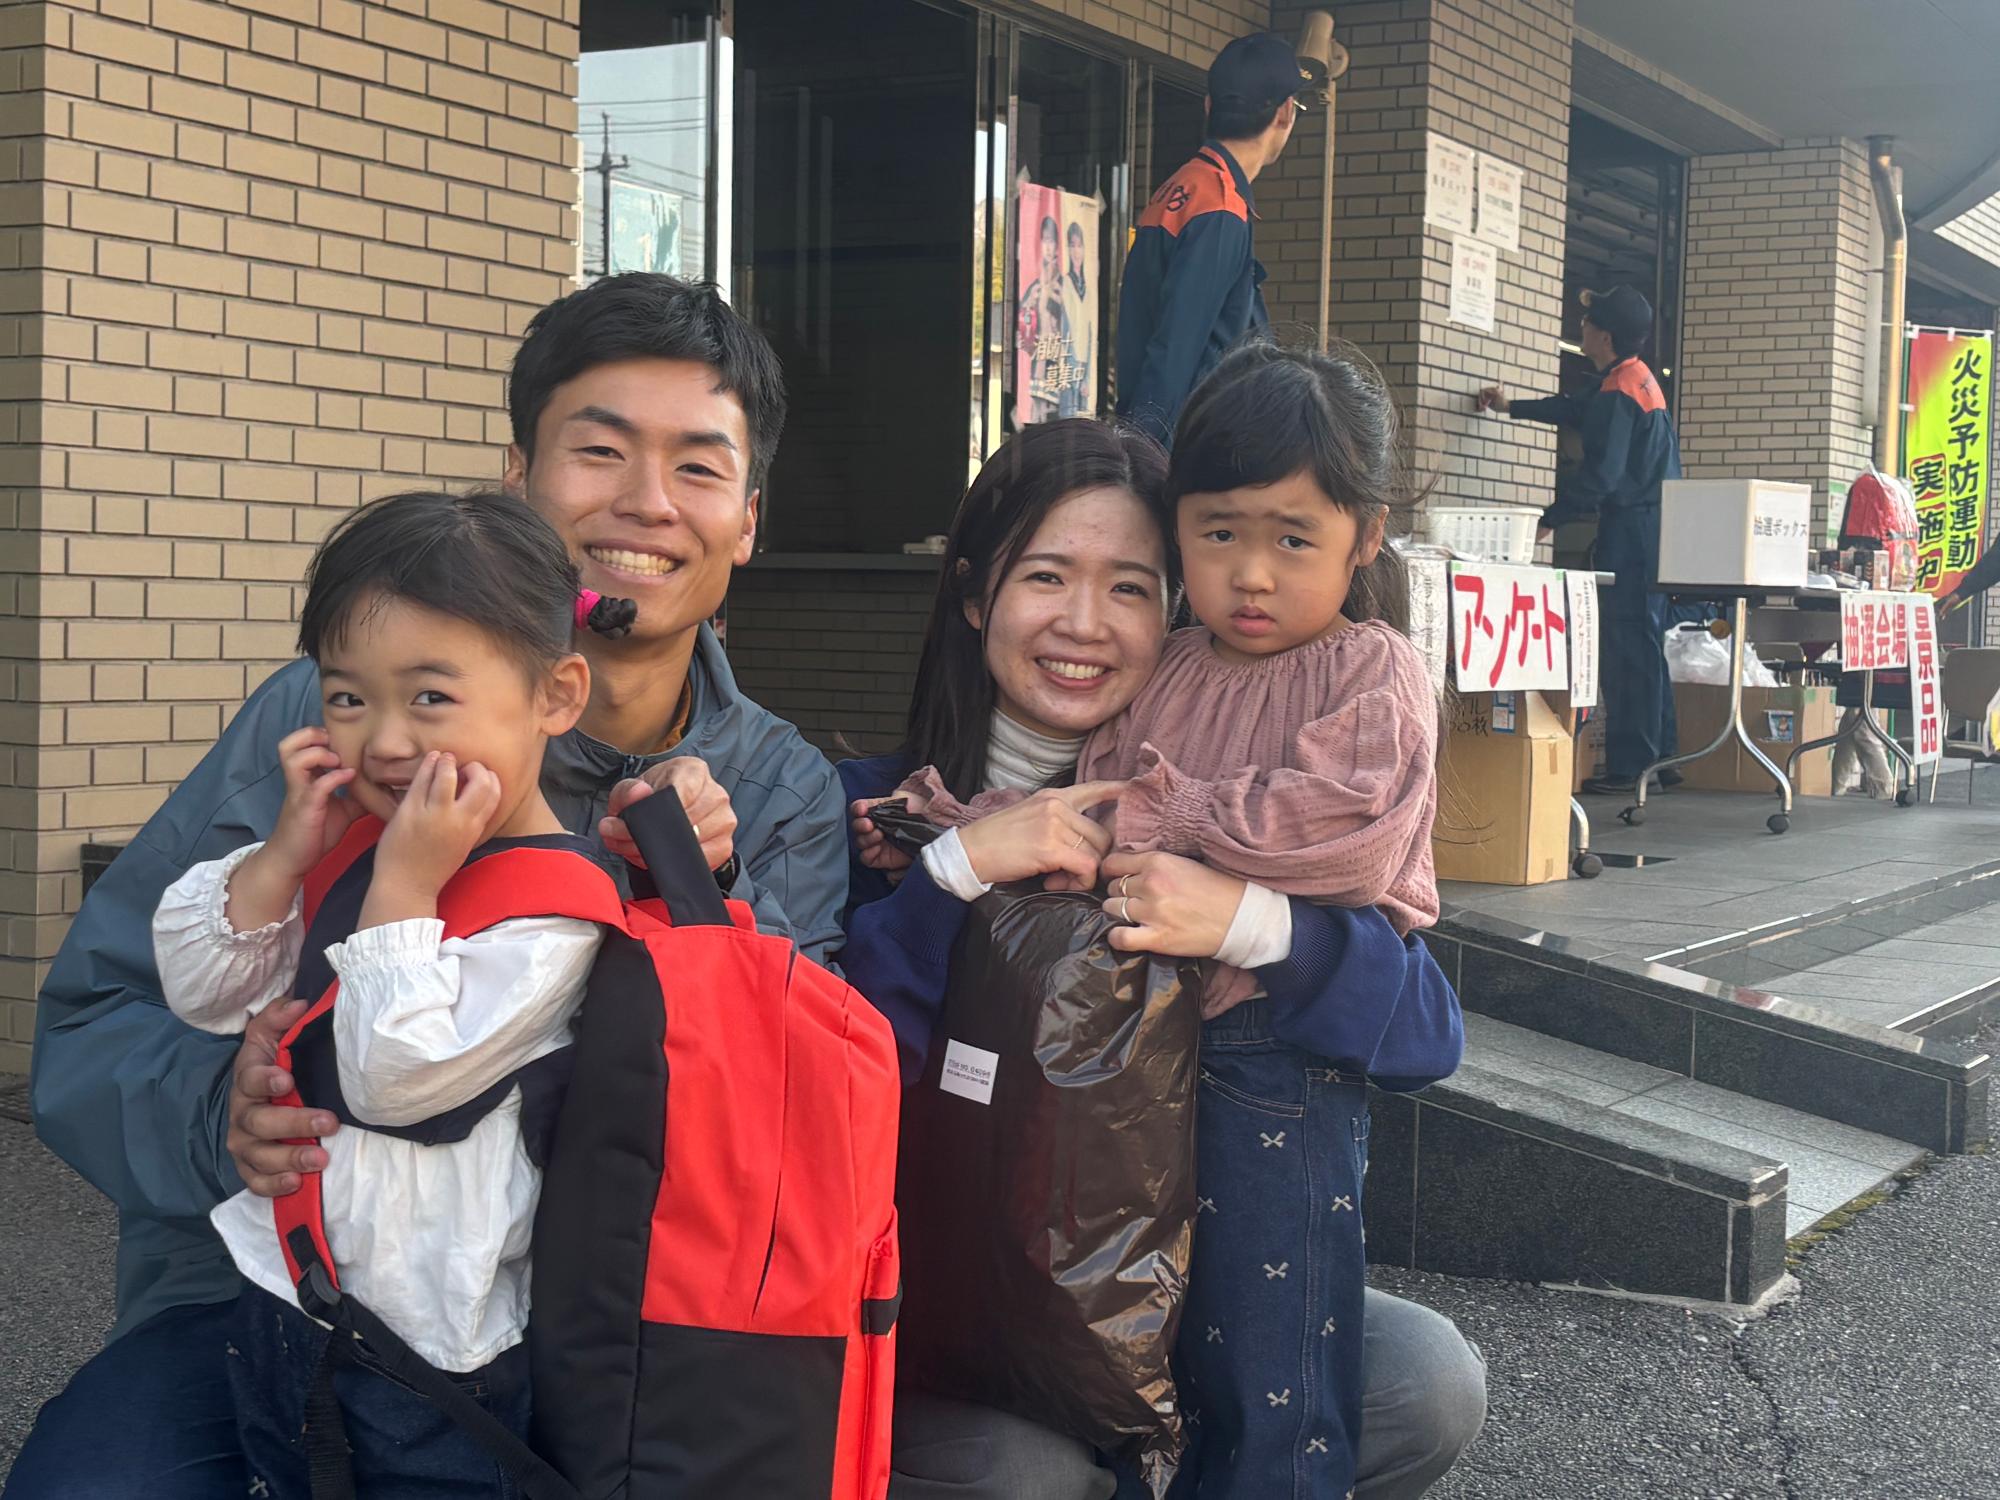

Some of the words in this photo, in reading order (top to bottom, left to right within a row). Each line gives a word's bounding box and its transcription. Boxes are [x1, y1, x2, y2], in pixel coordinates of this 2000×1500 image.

[1913, 459, 1944, 590] 実施中
[1946, 349, 1983, 570] 火災予防運動
[1454, 574, 1566, 688] アンケート
[1844, 602, 1907, 668] 抽選会場
[1915, 606, 1938, 754] 景品
